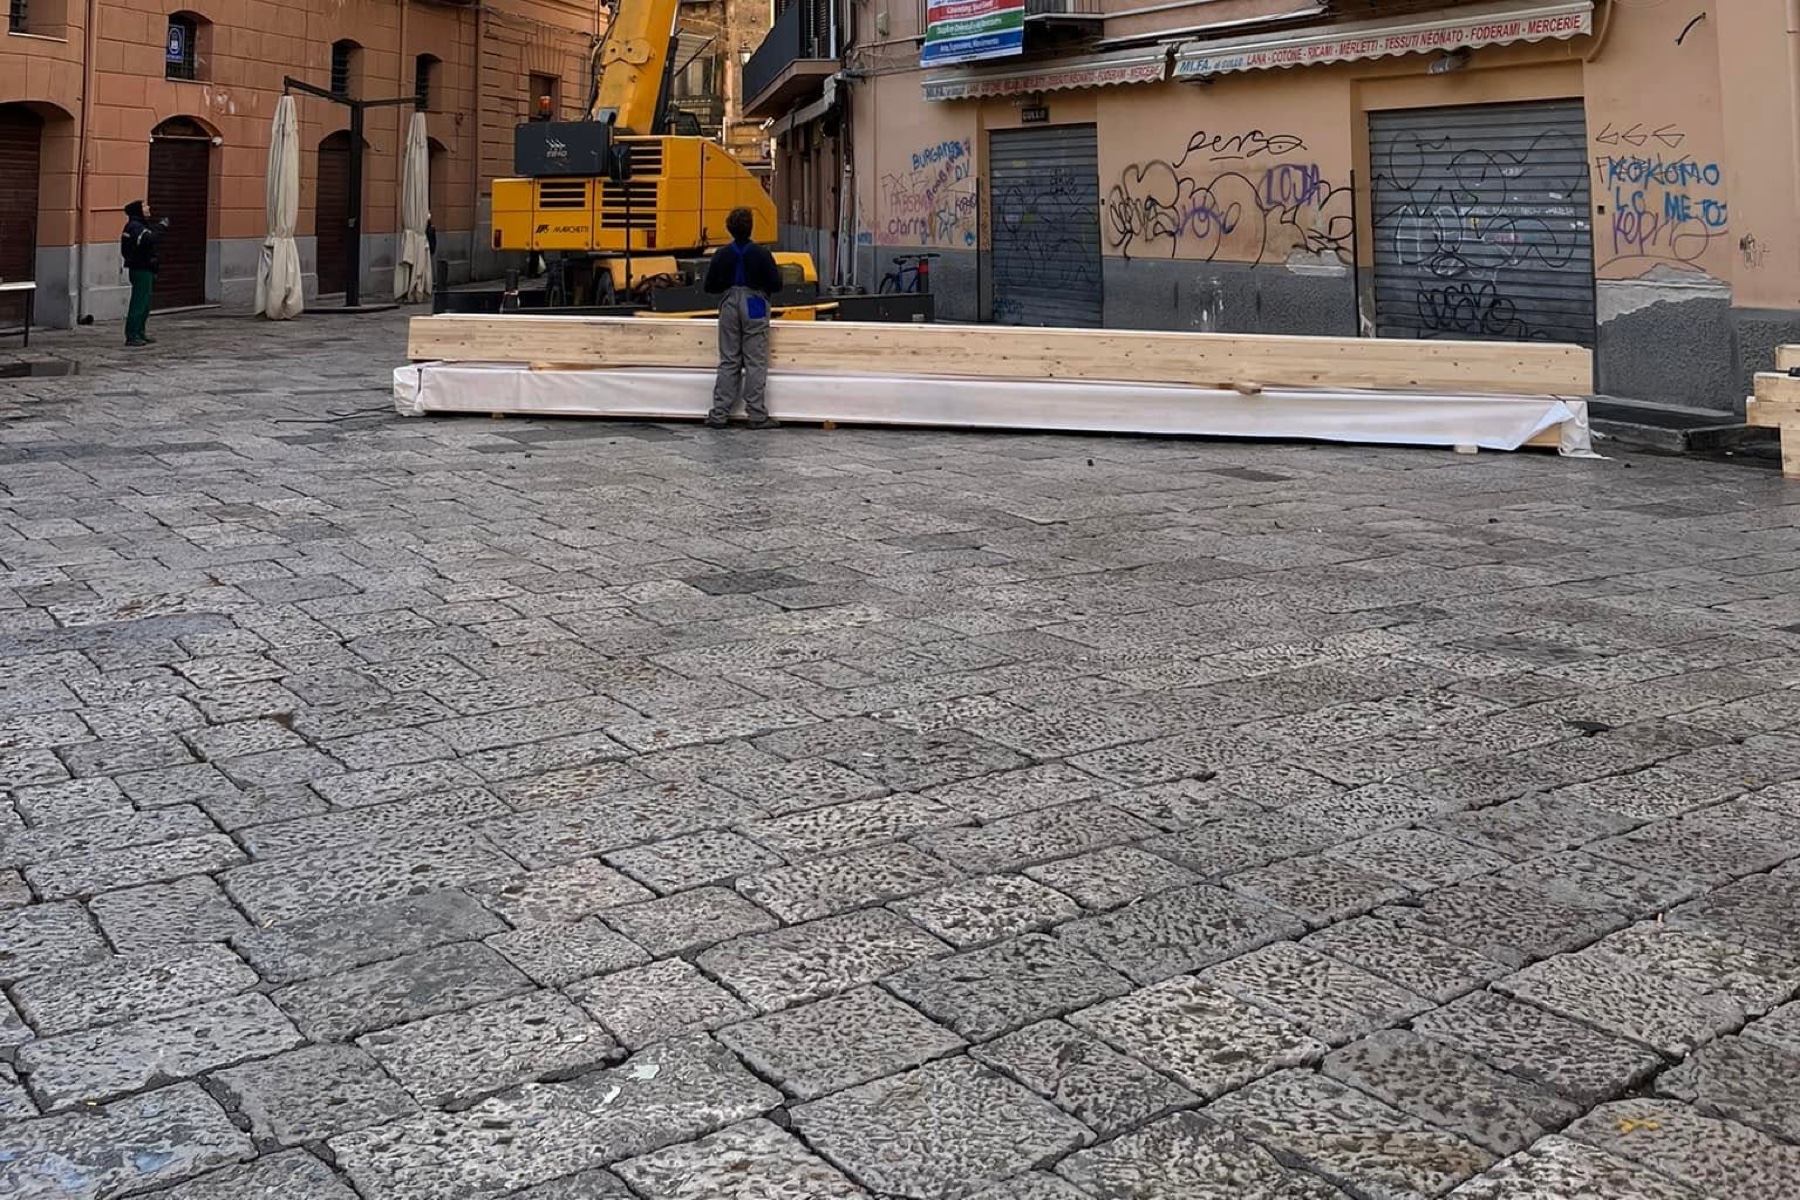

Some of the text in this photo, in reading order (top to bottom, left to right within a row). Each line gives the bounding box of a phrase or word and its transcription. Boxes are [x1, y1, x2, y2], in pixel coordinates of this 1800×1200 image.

[1272, 48, 1302, 62] COTONE
[1340, 40, 1379, 54] MERLETTI
[1420, 29, 1463, 46] NEONATO
[1470, 20, 1521, 40] FODERAMI
[1527, 14, 1582, 35] MERCERIE
